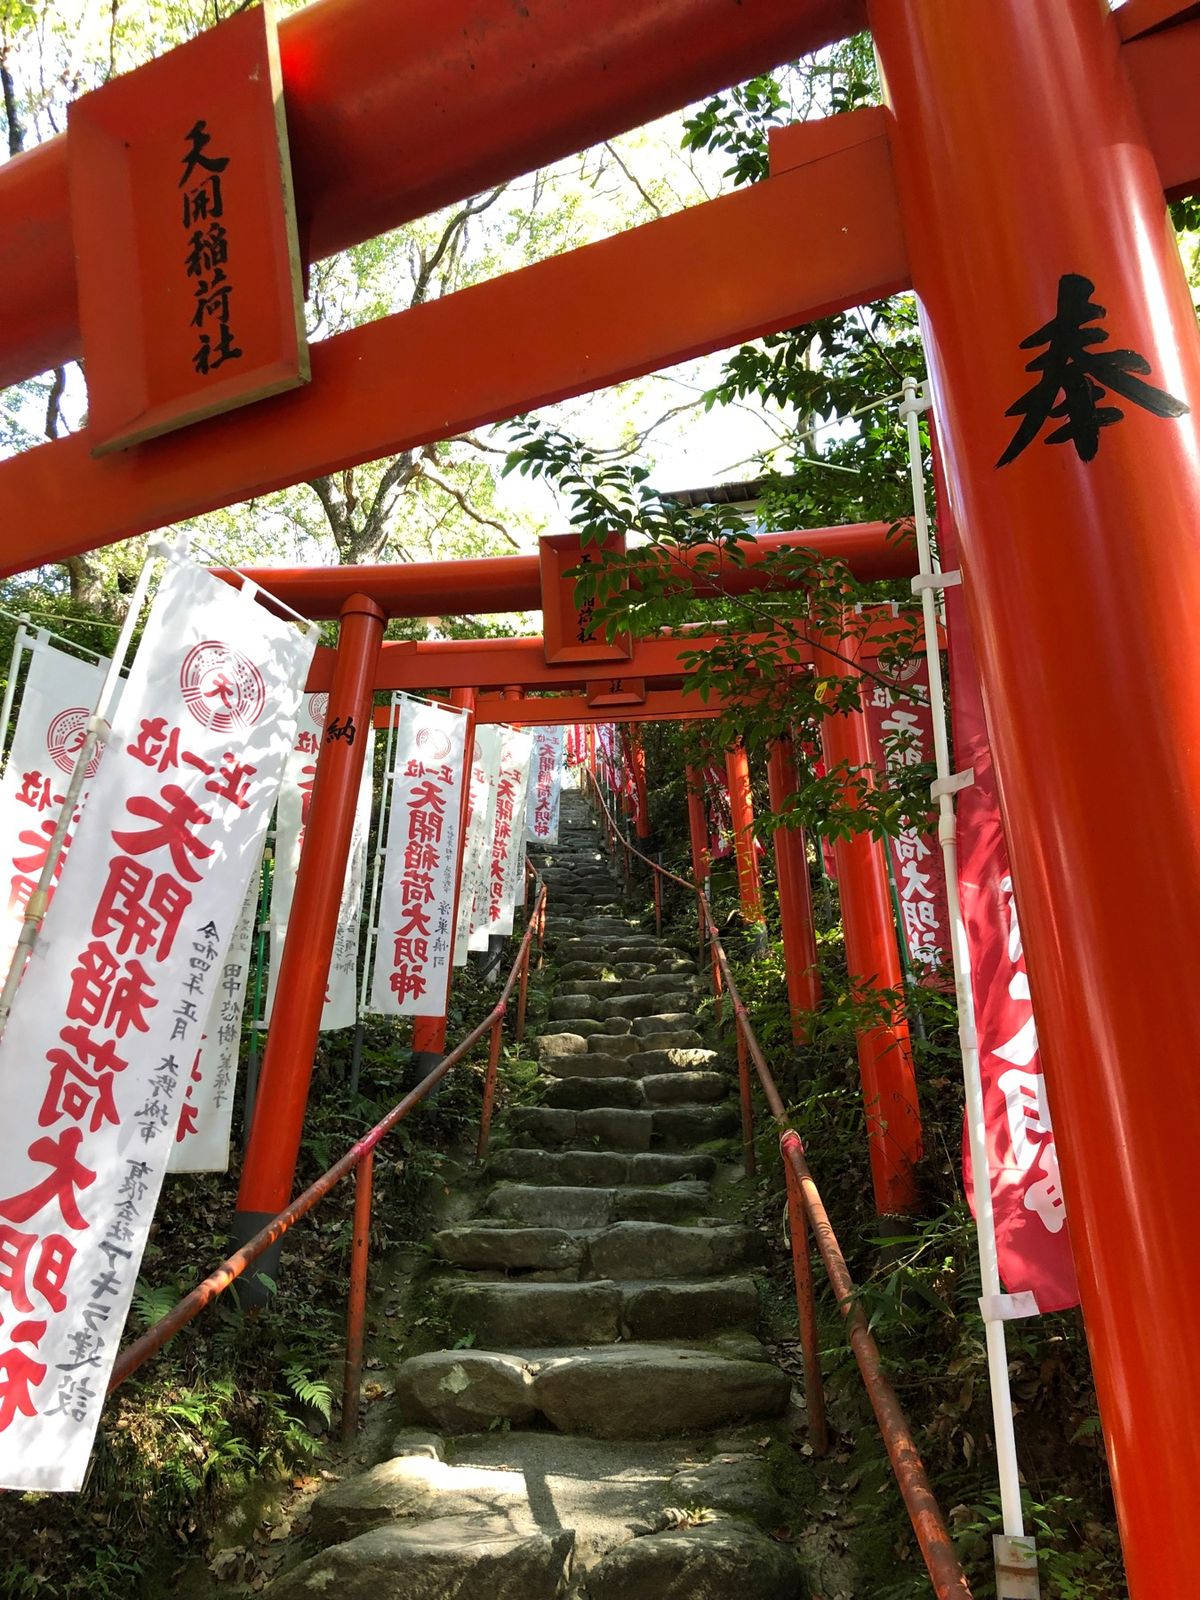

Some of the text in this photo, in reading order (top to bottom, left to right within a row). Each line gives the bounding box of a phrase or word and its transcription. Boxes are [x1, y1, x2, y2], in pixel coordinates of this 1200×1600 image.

[178, 119, 243, 375] 天開稲荷社
[993, 272, 1191, 472] 奉
[326, 716, 356, 746] 納
